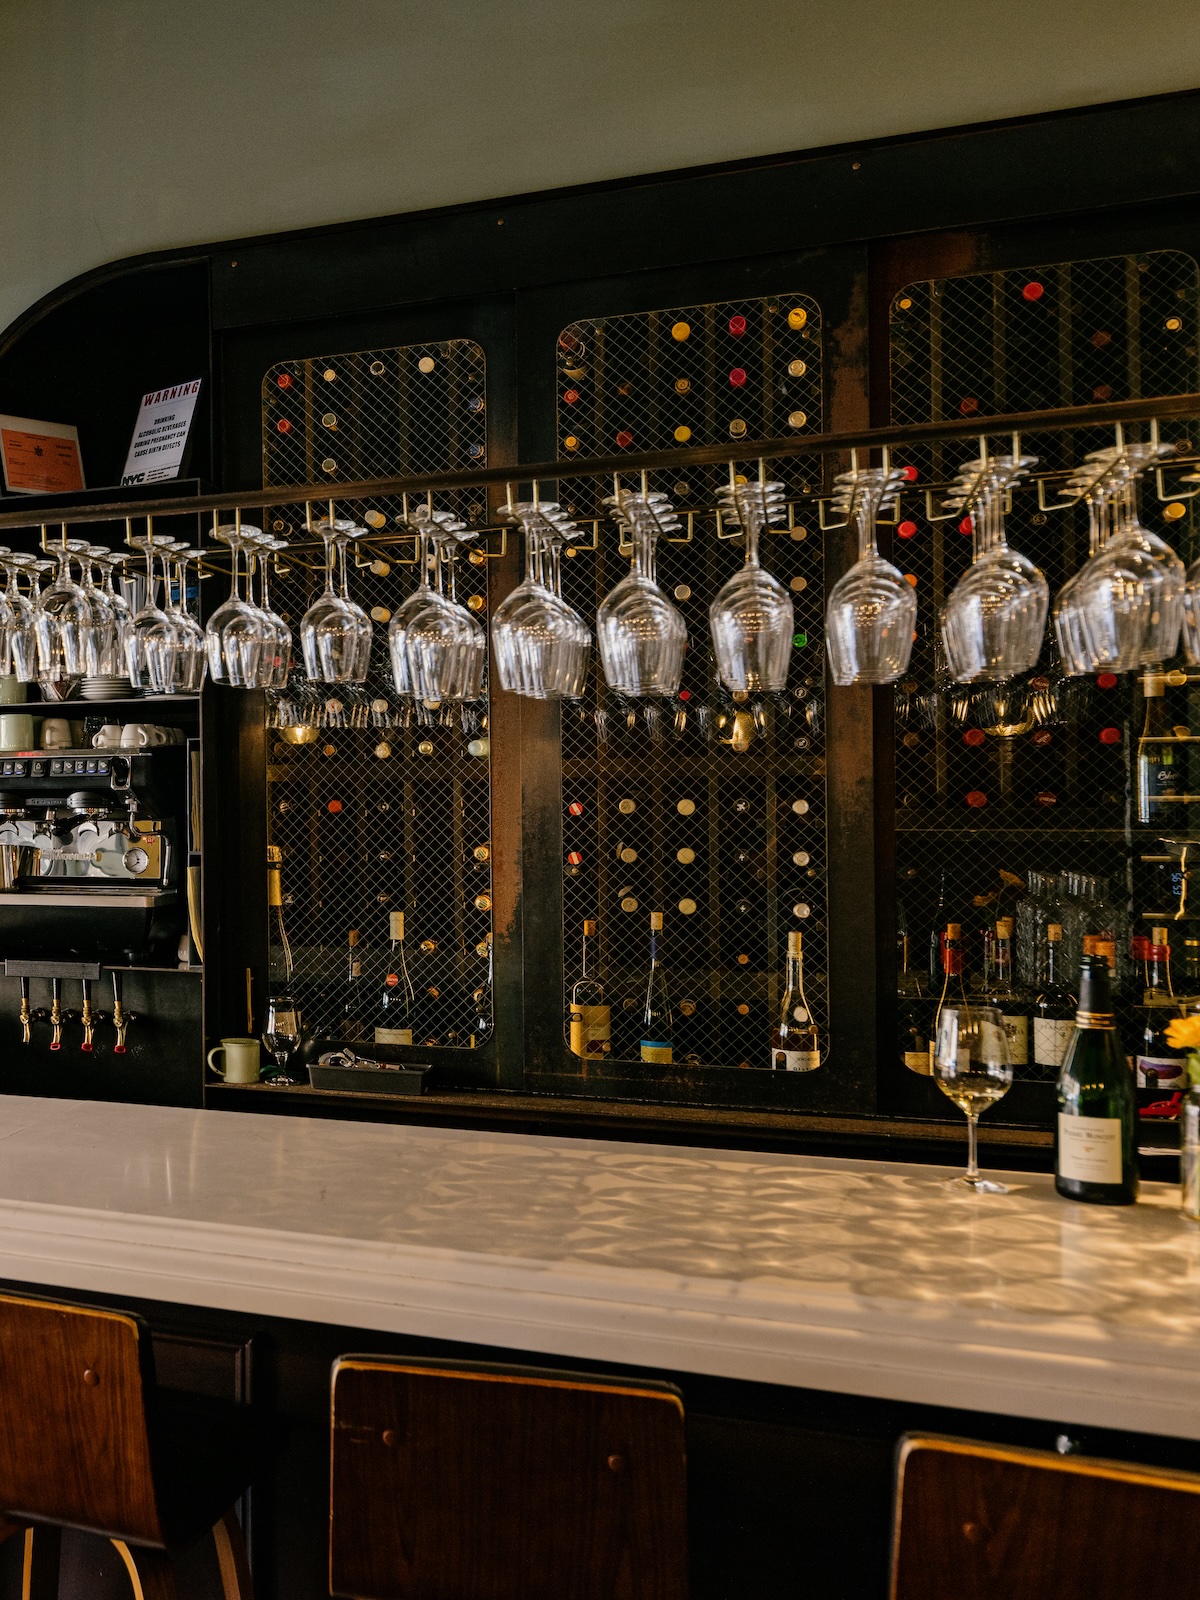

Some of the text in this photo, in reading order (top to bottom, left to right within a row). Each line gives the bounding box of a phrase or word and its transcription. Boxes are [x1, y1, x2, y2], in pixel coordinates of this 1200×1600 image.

[144, 381, 199, 407] WARNING
[154, 414, 176, 425] DRINKING
[138, 420, 187, 439] ALCOHOLIC BEVERAGES
[133, 430, 186, 449] DURING PREGNANCY CAN
[134, 441, 181, 458] CAUSE BIRTH DEFECTS
[121, 472, 146, 486] NYC
